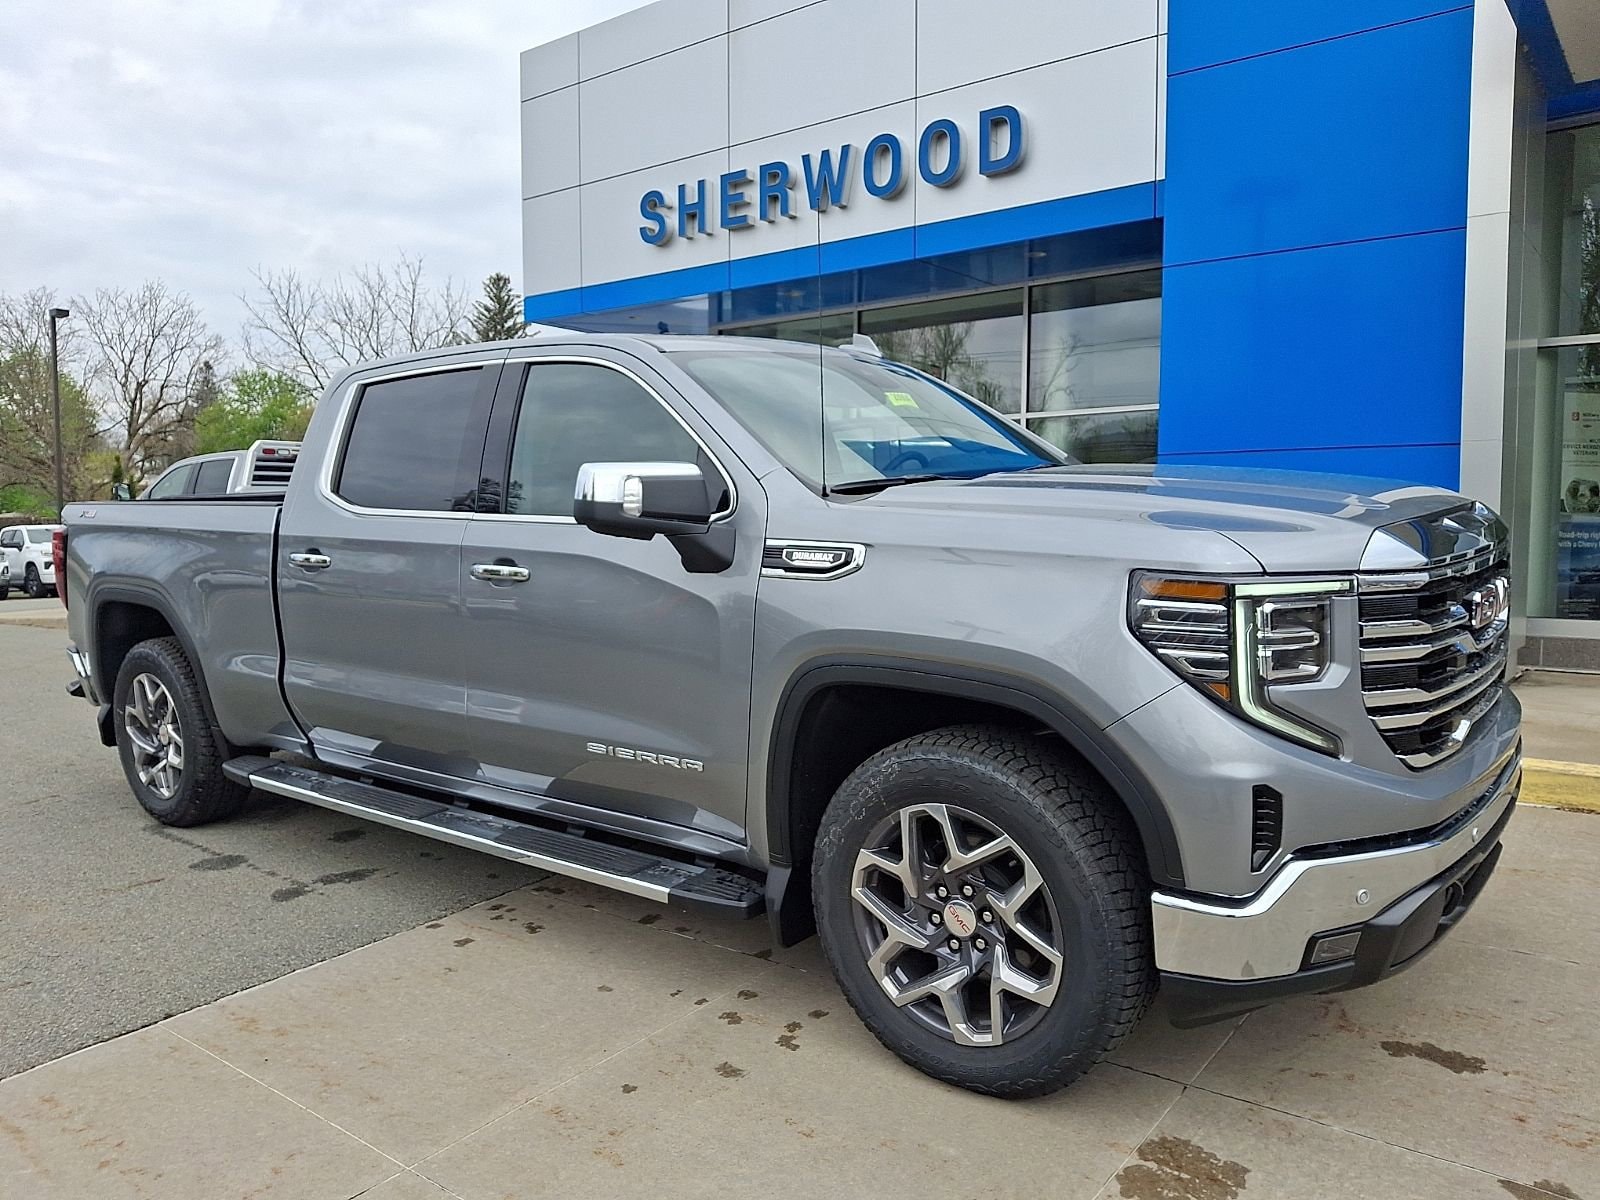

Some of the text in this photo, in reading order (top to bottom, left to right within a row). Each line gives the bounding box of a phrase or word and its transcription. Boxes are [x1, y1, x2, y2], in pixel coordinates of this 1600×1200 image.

[639, 104, 1027, 247] SHERWOOD
[792, 551, 835, 562] DURAMAX
[586, 742, 705, 772] SIERRA
[948, 905, 971, 934] GMC
